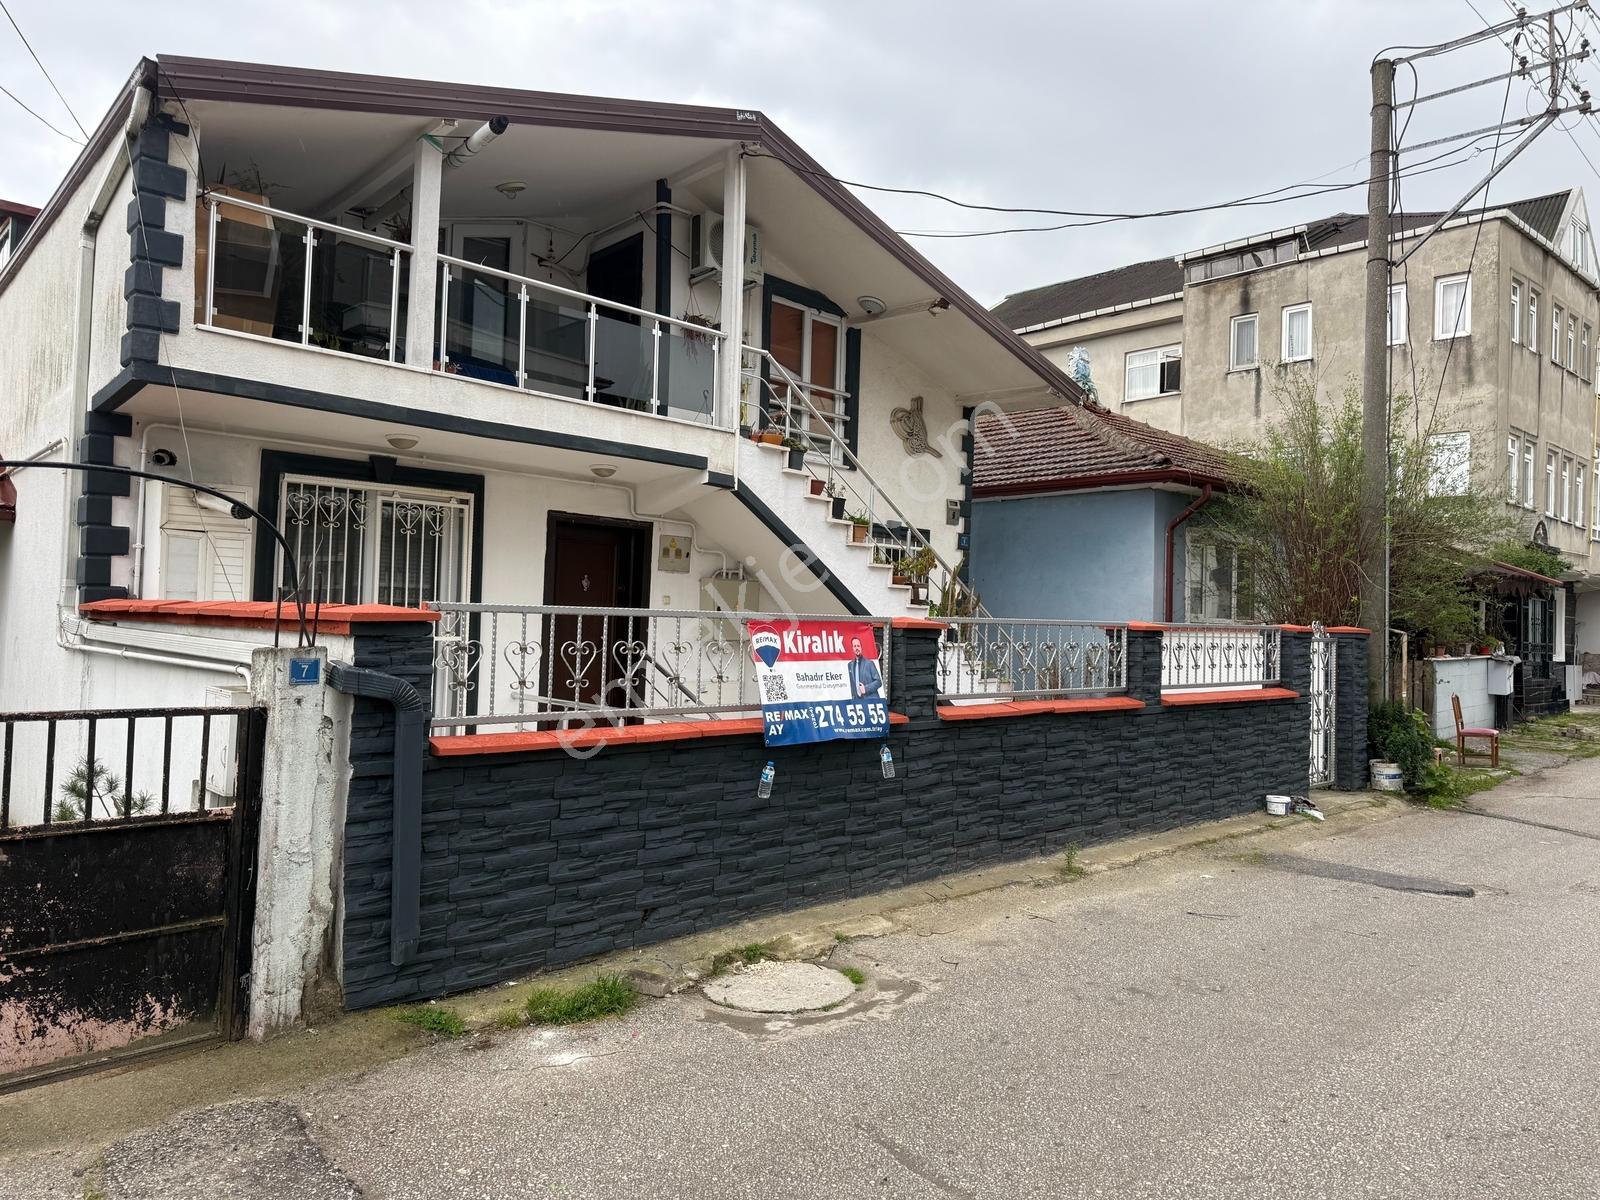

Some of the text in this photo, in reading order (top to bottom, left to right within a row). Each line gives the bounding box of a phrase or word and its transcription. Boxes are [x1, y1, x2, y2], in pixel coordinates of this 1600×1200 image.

[755, 636, 778, 645] RE/MAX
[783, 630, 846, 654] Kiralık
[301, 664, 309, 678] 7
[796, 672, 842, 681] Bahadır Eker
[765, 709, 809, 722] RE/MAX
[815, 705, 844, 728] 274
[846, 704, 866, 726] 55
[867, 703, 887, 725] 55
[769, 724, 784, 736] AY
